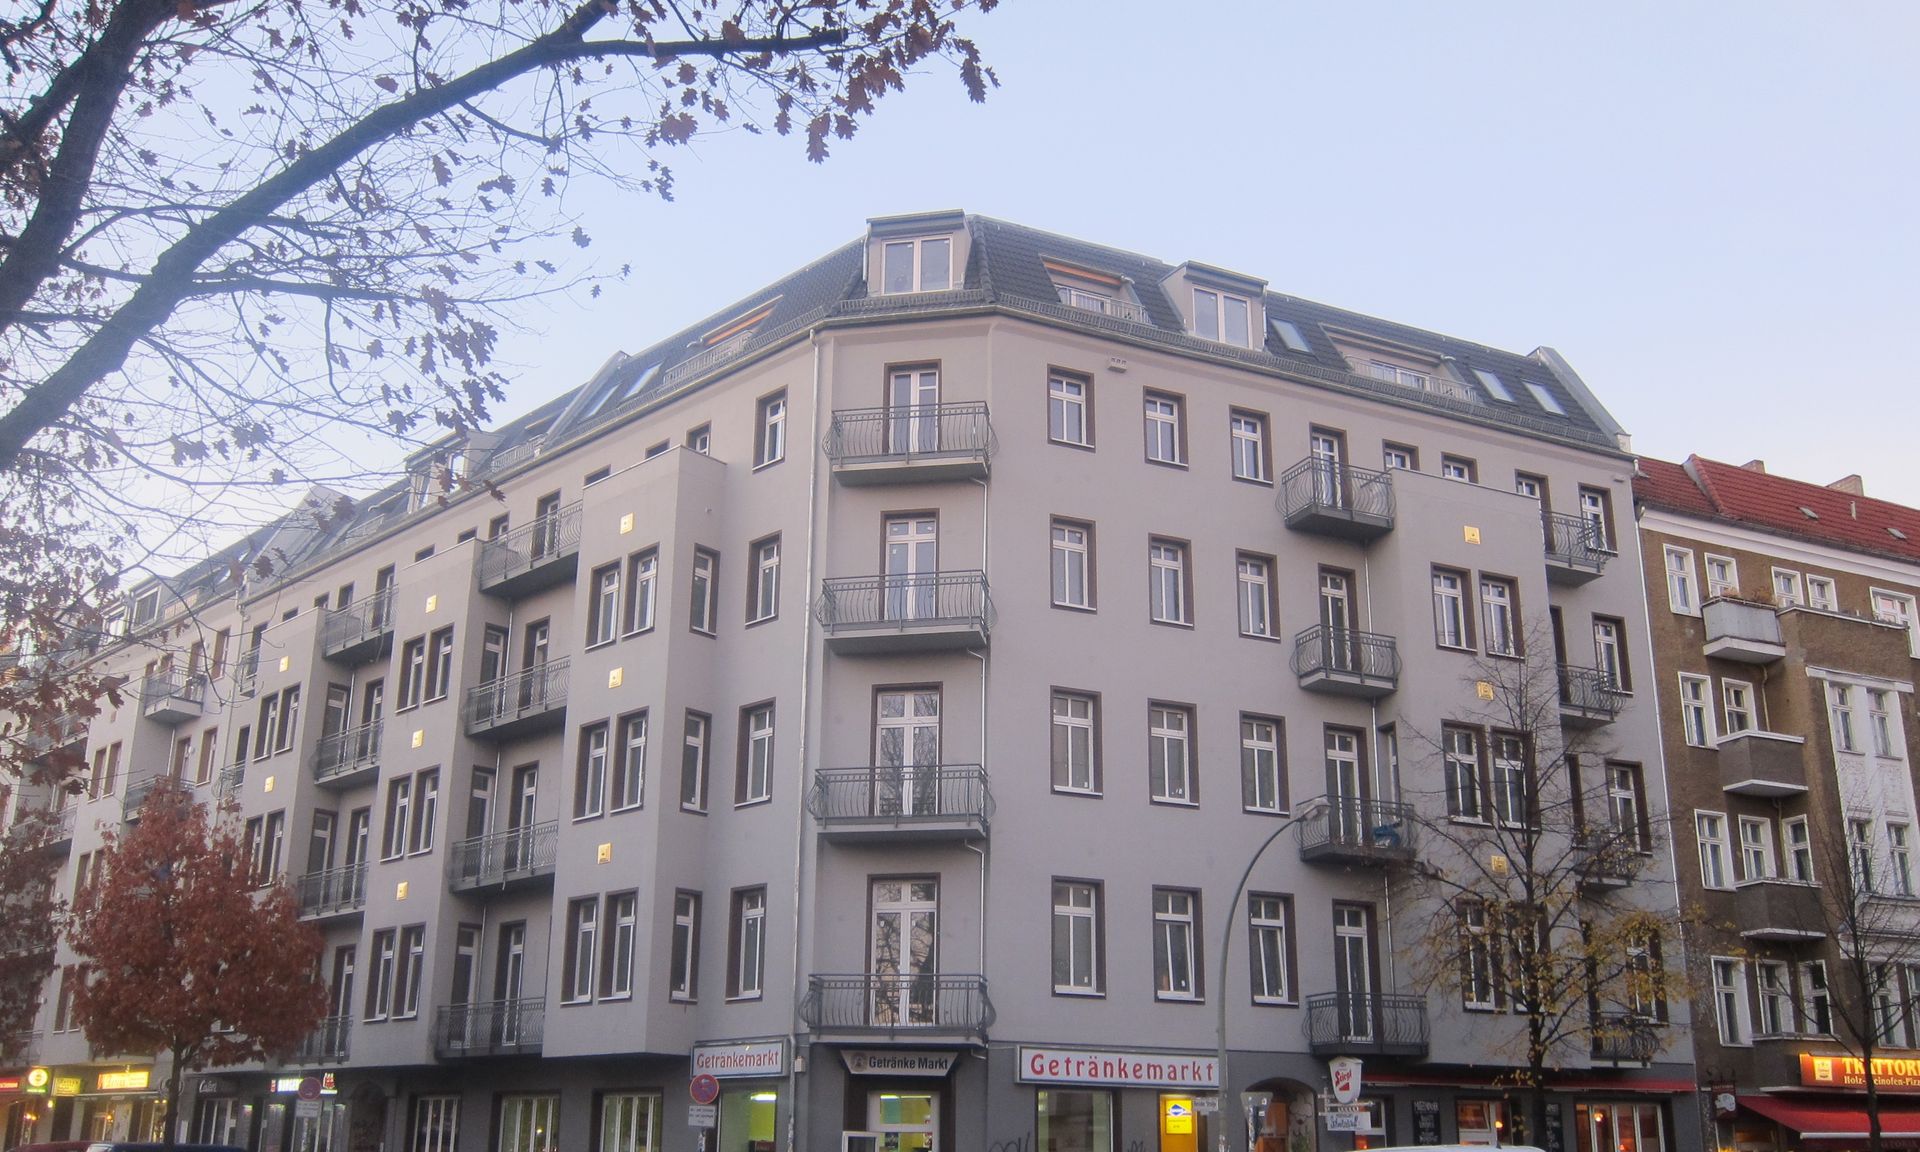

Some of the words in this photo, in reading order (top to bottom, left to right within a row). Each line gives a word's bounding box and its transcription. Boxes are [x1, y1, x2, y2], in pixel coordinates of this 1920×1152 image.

[696, 1050, 779, 1069] Getränkemarkt
[868, 1056, 916, 1069] Getränke
[917, 1057, 948, 1070] Markt
[1030, 1053, 1214, 1081] Getränkemarkt
